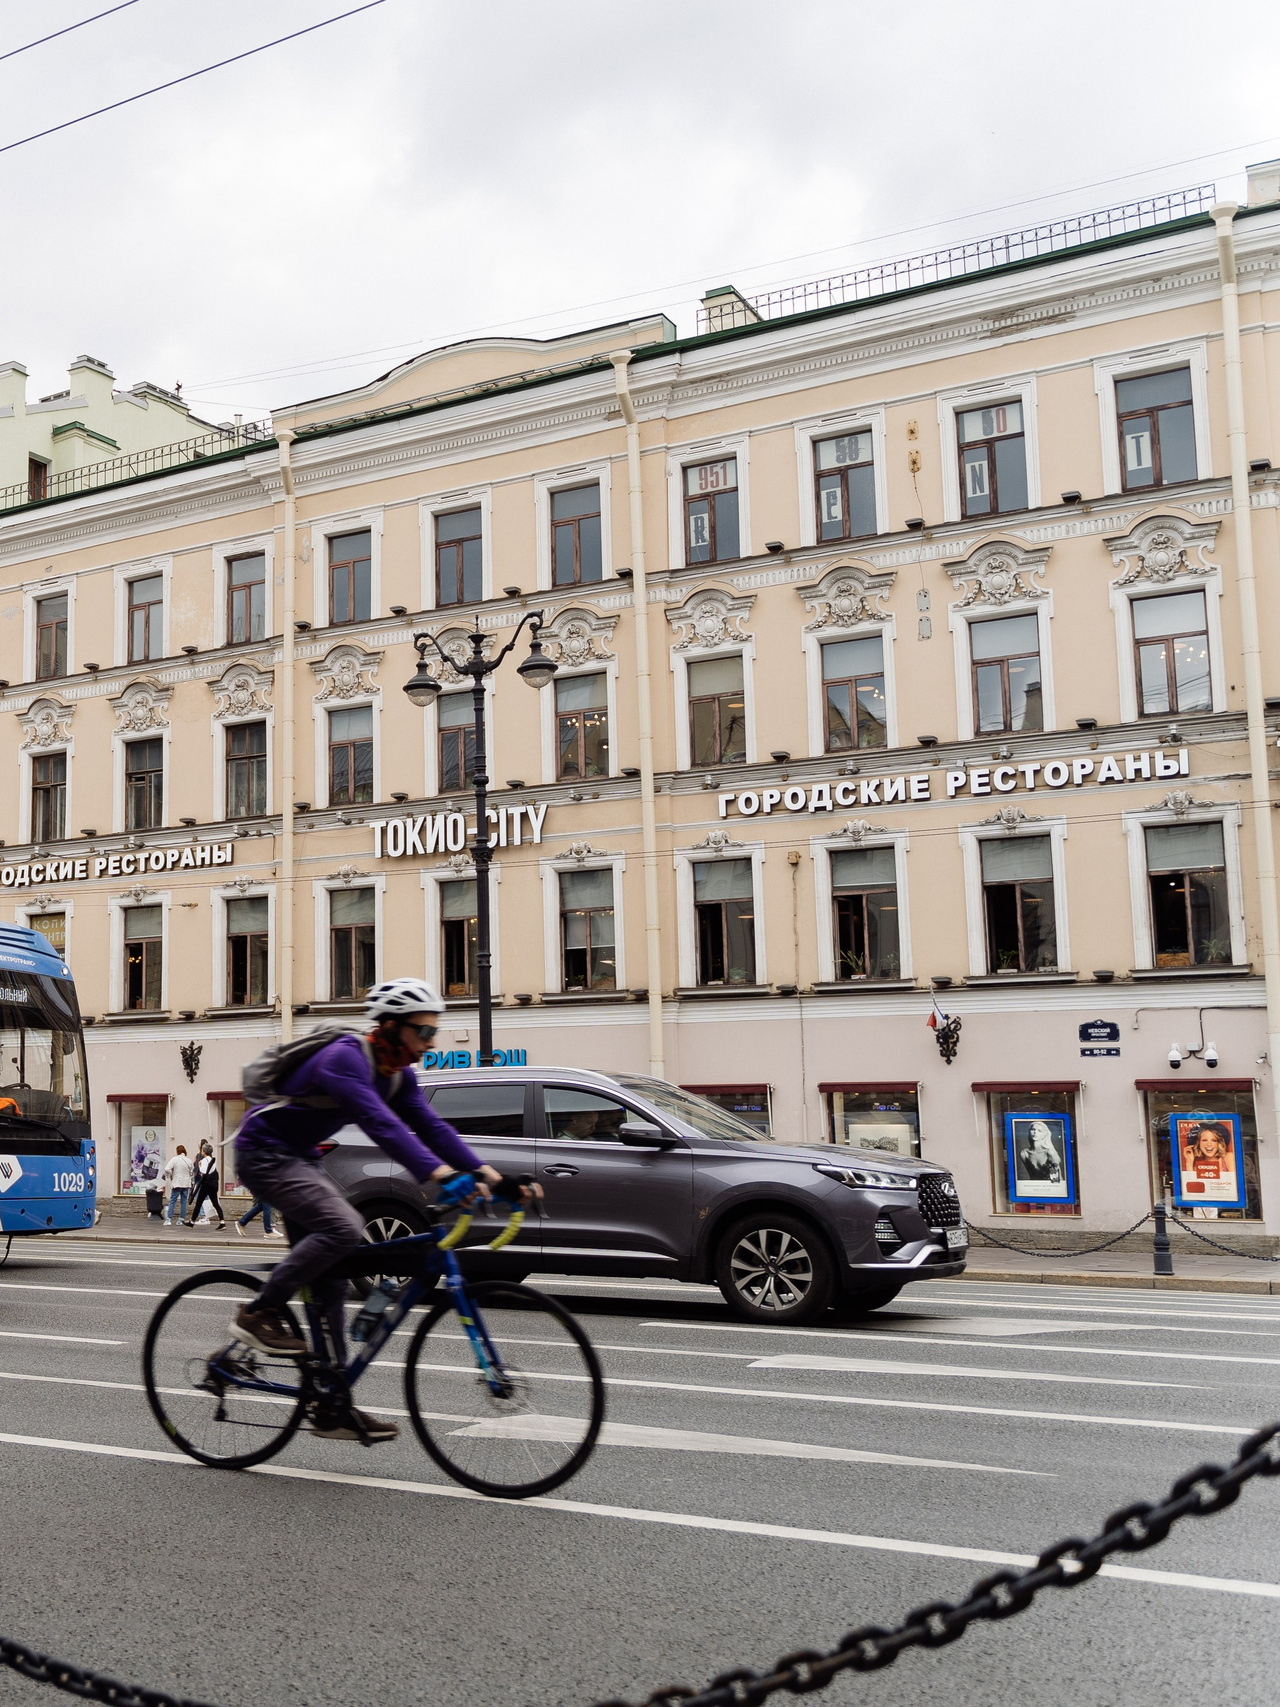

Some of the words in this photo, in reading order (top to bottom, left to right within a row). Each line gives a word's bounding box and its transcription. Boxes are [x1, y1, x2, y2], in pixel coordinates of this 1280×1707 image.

[698, 462, 728, 491] 951
[970, 463, 985, 495] N
[1130, 434, 1145, 467] T
[718, 774, 931, 818] ГОРОДСКИЕ
[946, 748, 1190, 797] РЕСТОРАНЫ
[94, 843, 233, 878] РЕСТОРАНЫ
[423, 1050, 471, 1069] РИВ
[53, 1172, 85, 1192] 1029
